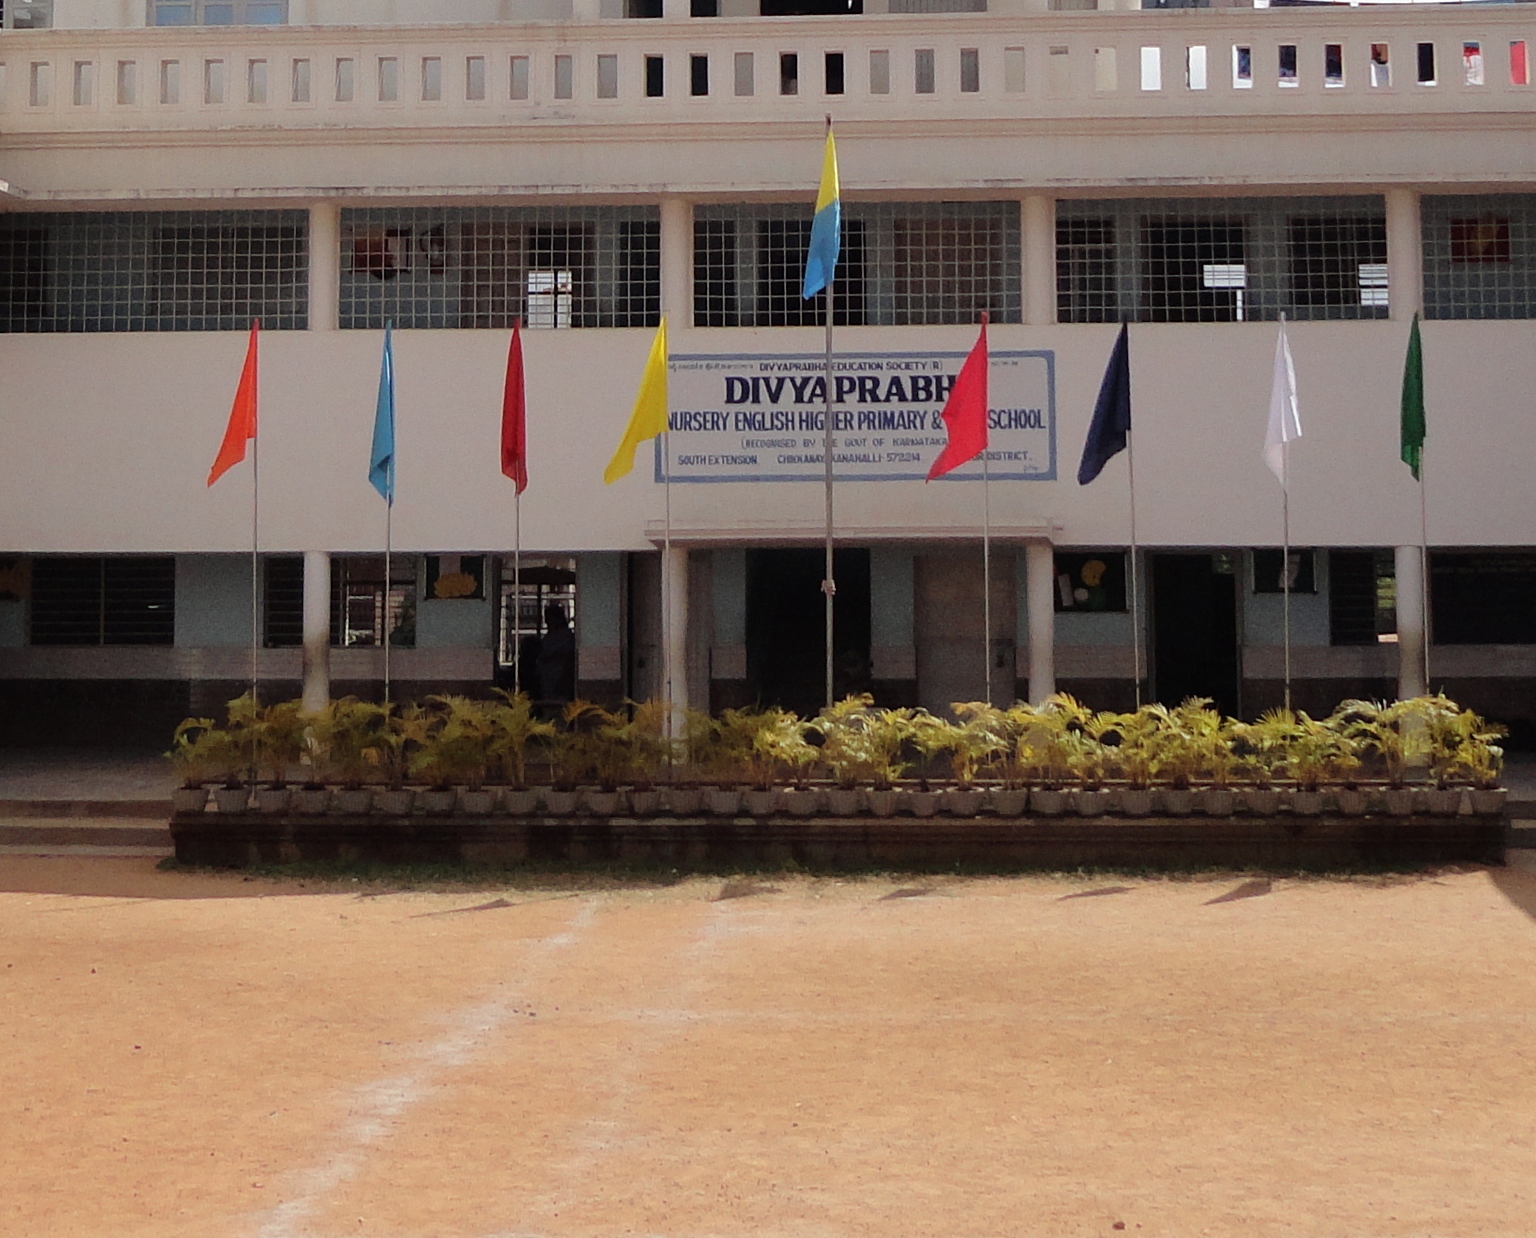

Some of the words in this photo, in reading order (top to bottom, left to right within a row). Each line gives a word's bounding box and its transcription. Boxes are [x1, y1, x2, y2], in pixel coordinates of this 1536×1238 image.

[759, 362, 827, 372] DIVYAPRABHA
[832, 362, 883, 371] EDUCATION
[886, 362, 928, 371] SOCIETY
[725, 375, 957, 404] DIVYAPRABH
[735, 411, 795, 431] ENGLISH
[858, 410, 928, 430] PRIMARY
[931, 410, 942, 430] &
[987, 409, 1046, 429] SCHOOL
[872, 438, 885, 447] OF
[677, 454, 707, 466] SOUTH
